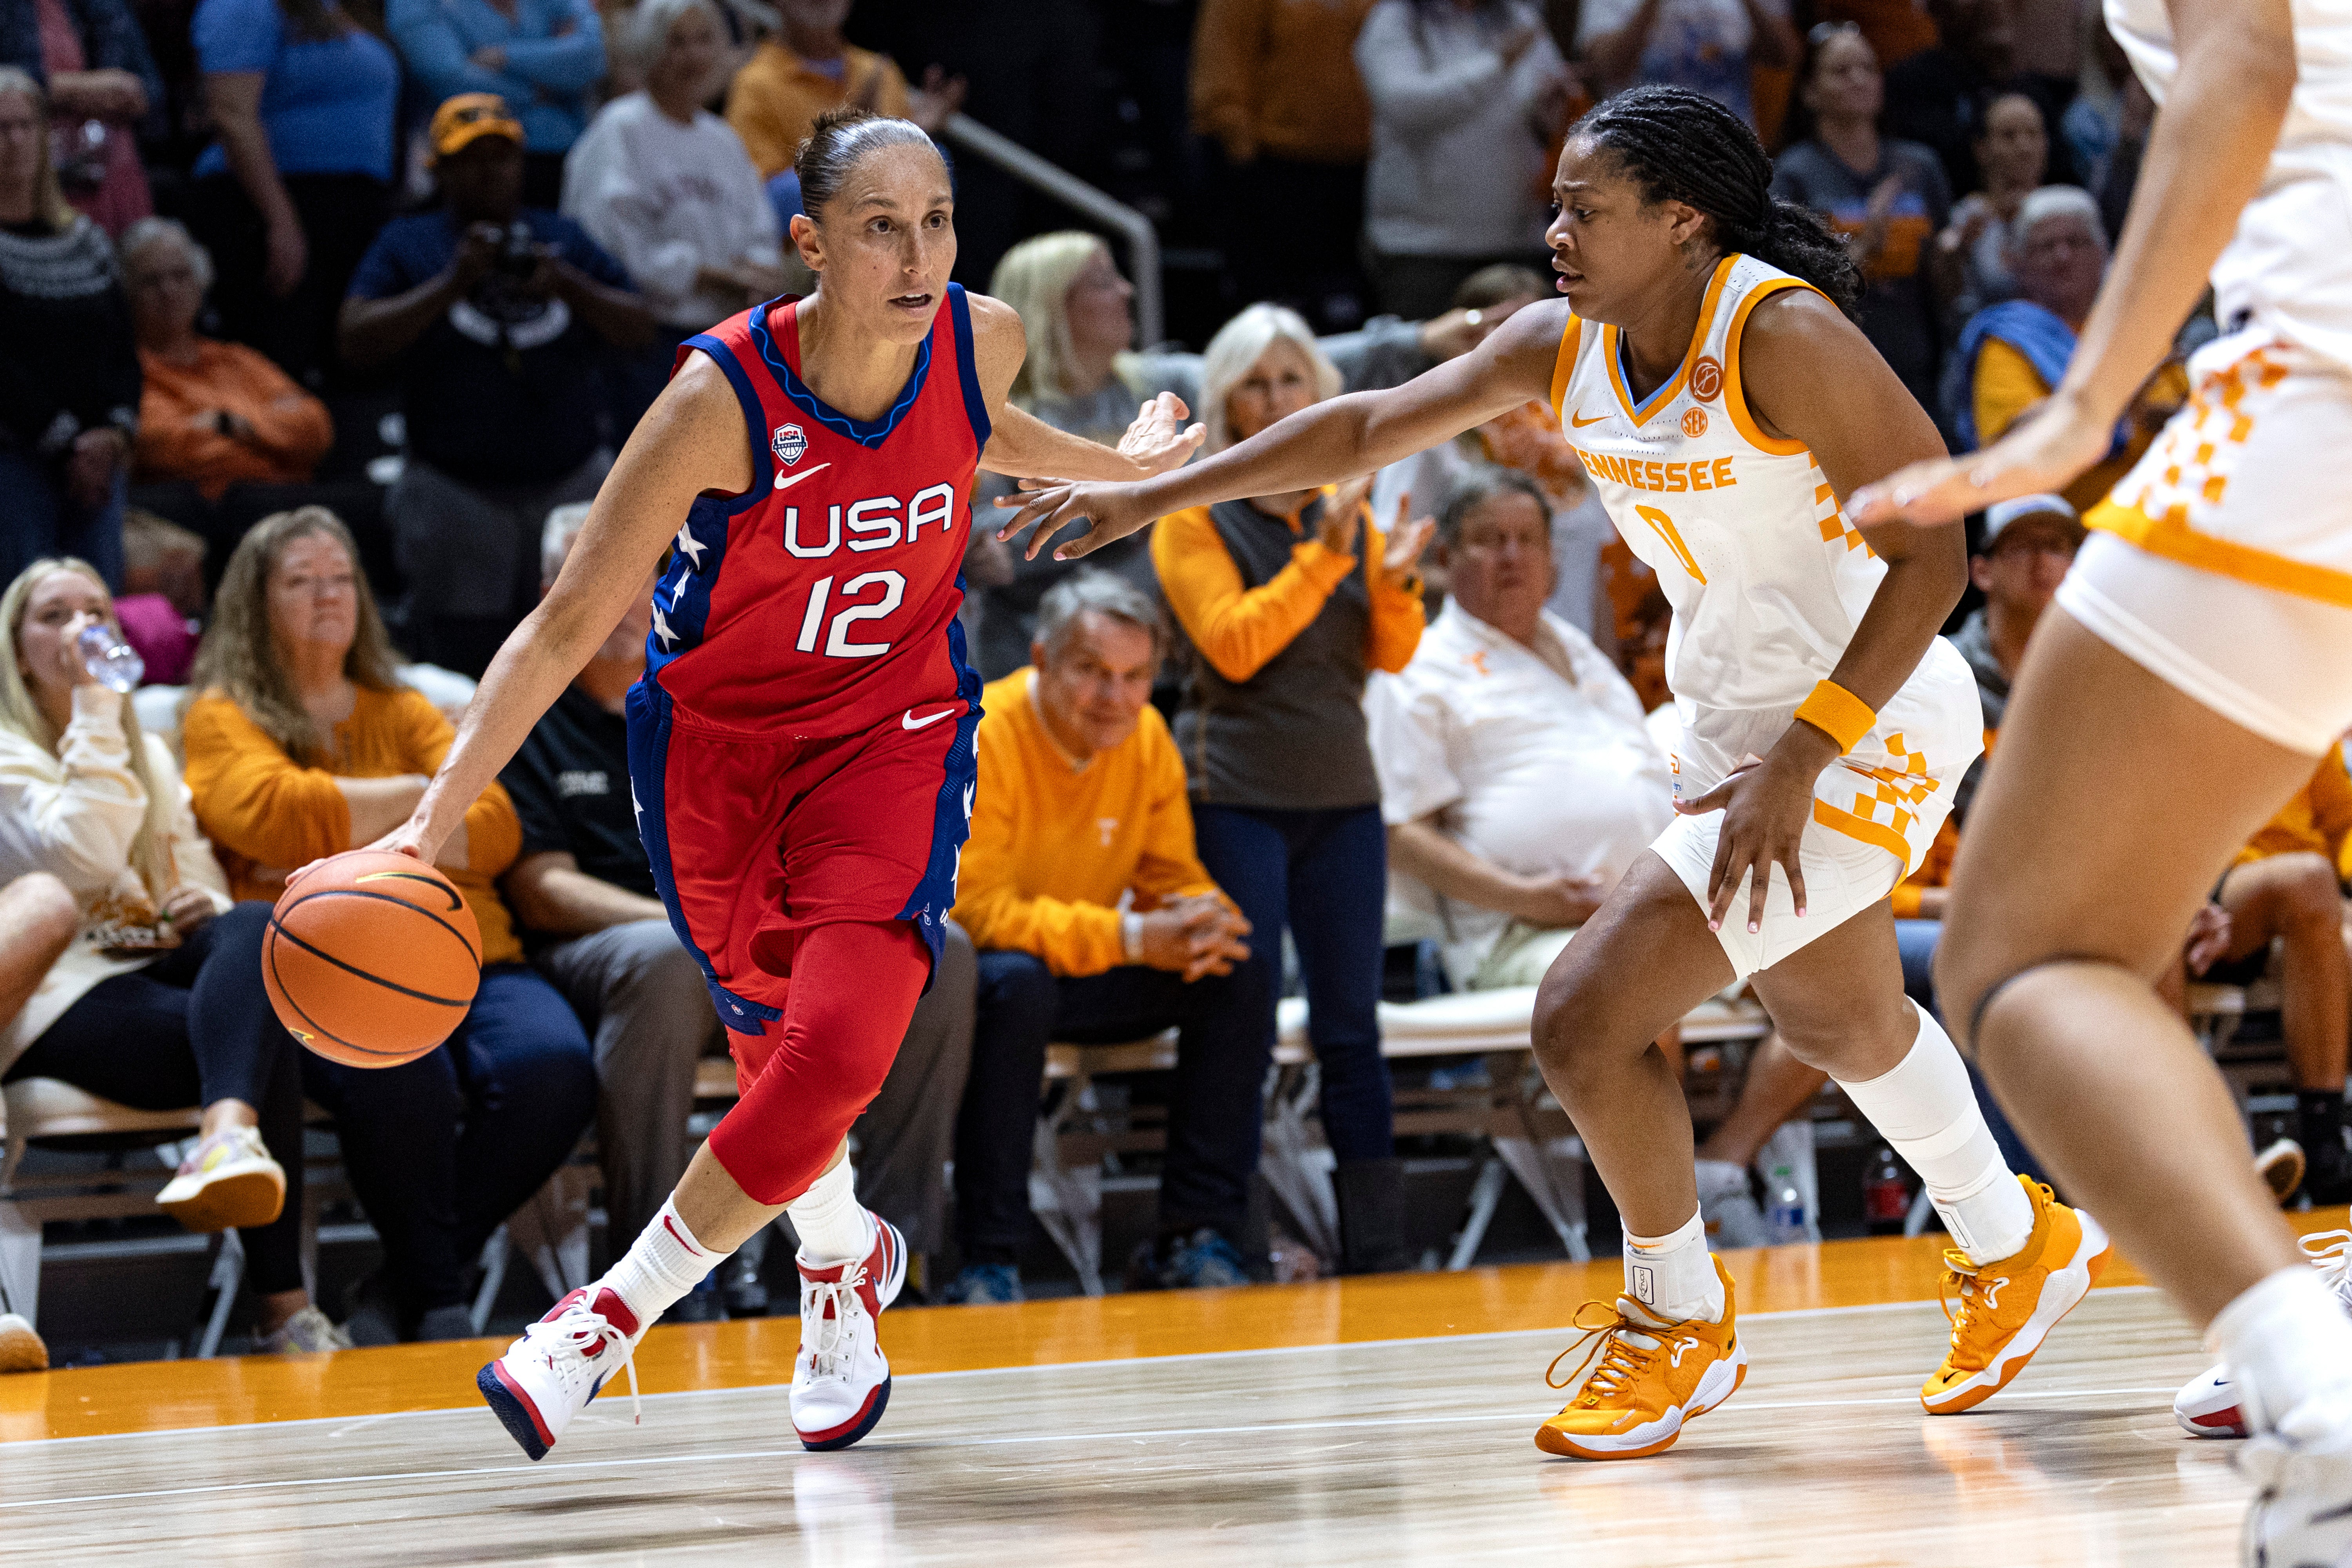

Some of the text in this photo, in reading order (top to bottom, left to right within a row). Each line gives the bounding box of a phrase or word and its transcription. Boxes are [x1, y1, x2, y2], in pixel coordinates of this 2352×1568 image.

[779, 431, 800, 441] USA
[1684, 409, 1706, 435] SEC
[1570, 445, 1737, 492] ENNESSEE
[784, 481, 954, 558] USA
[1635, 504, 1707, 586] 0
[796, 570, 906, 657] 12
